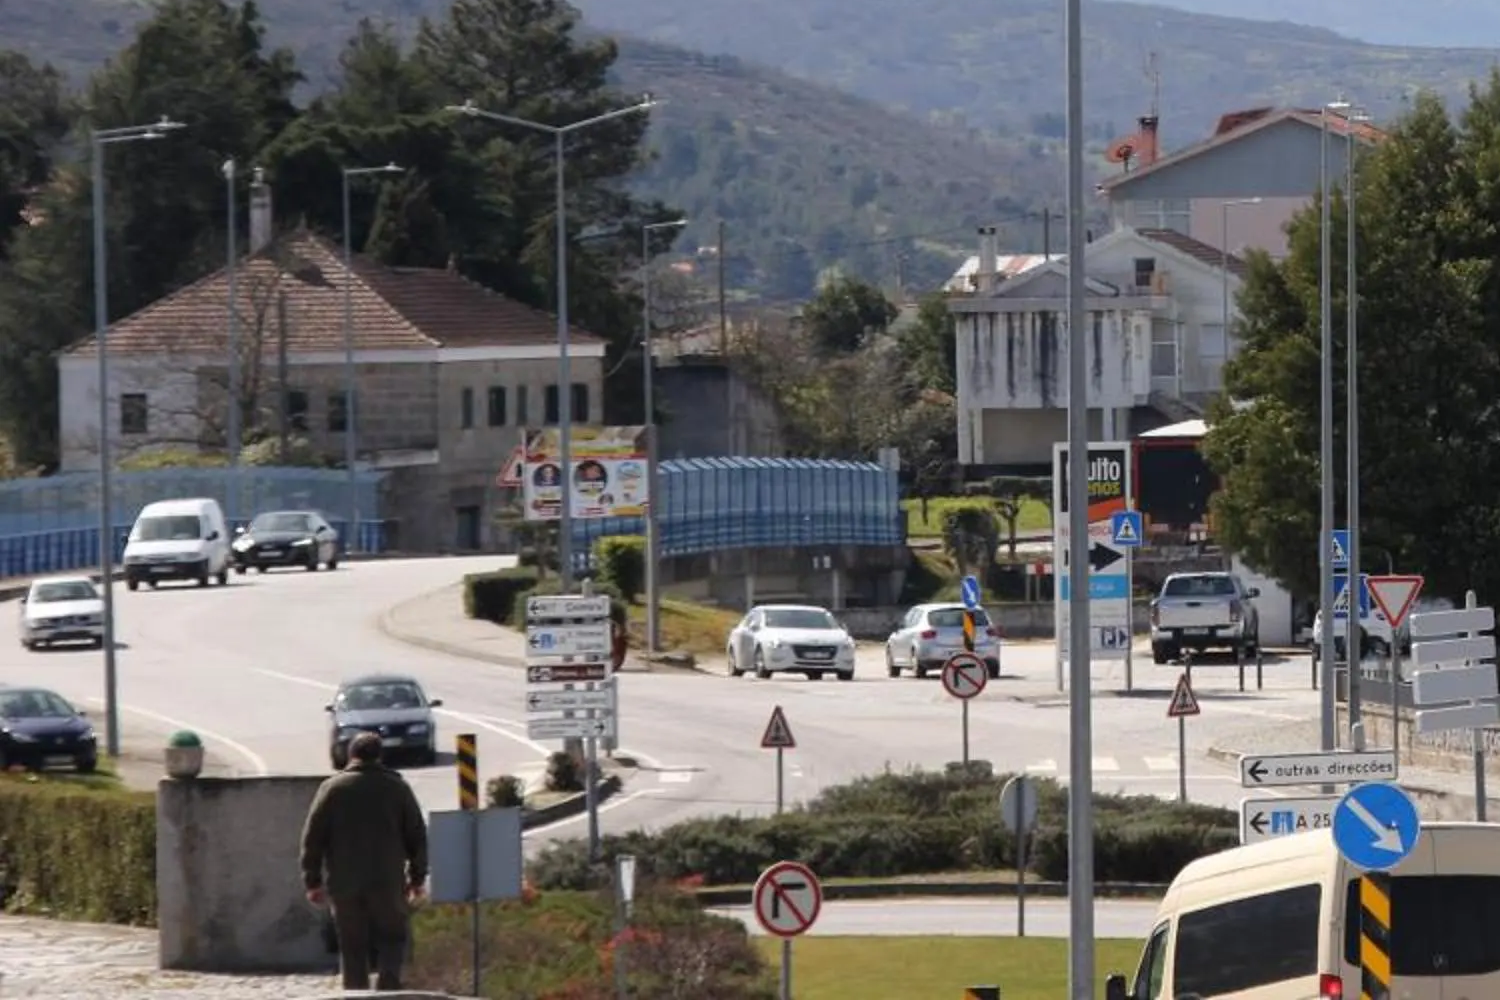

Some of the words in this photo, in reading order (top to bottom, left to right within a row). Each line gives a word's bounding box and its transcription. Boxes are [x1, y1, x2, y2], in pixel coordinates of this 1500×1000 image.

[1275, 764, 1320, 777] outras
[1296, 813, 1308, 829] A
[1313, 813, 1331, 829] 25
